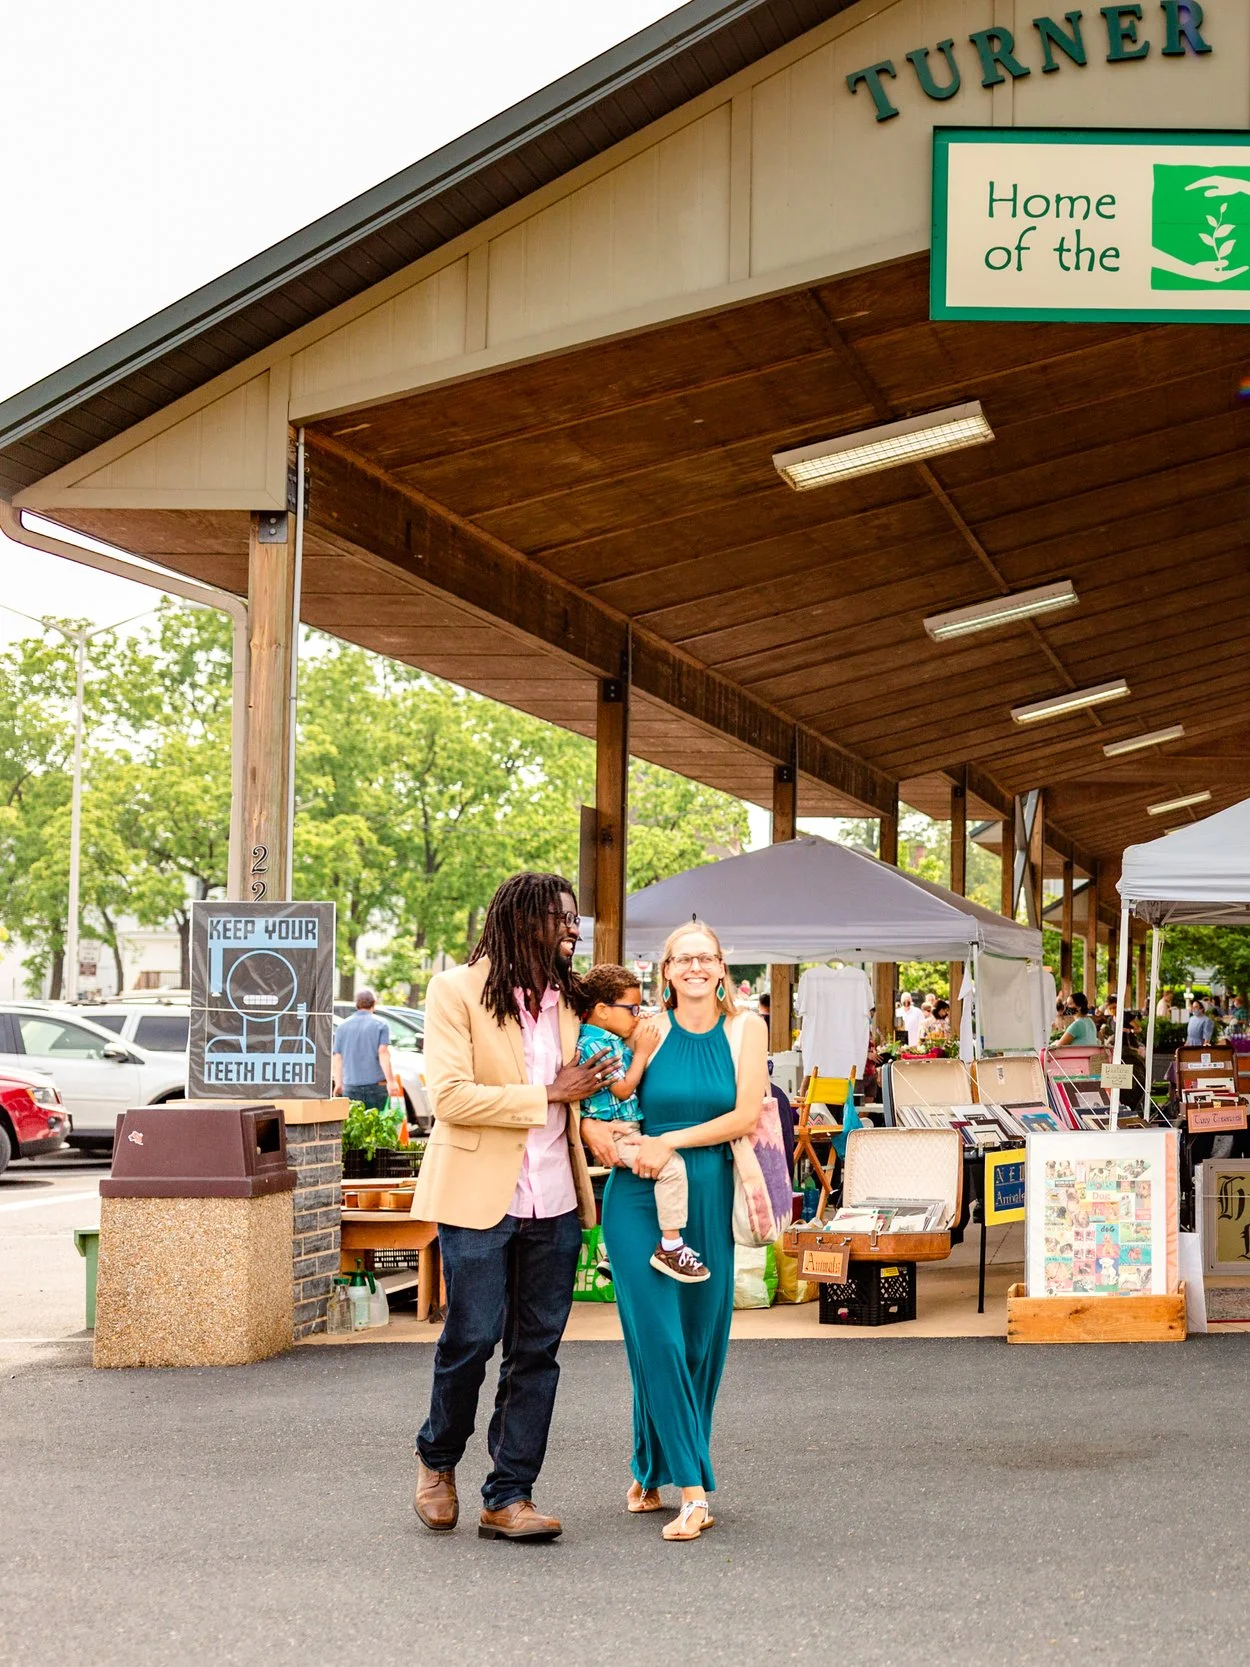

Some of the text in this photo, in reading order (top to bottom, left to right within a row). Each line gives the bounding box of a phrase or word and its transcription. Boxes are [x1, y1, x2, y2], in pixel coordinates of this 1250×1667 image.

[846, 0, 1213, 122] TURNER
[987, 180, 1117, 221] Home
[983, 225, 1121, 273] of the
[208, 919, 317, 941] KEEP YOUR
[205, 1061, 315, 1083] TEETH CLEAN
[804, 1252, 841, 1274] Animals
